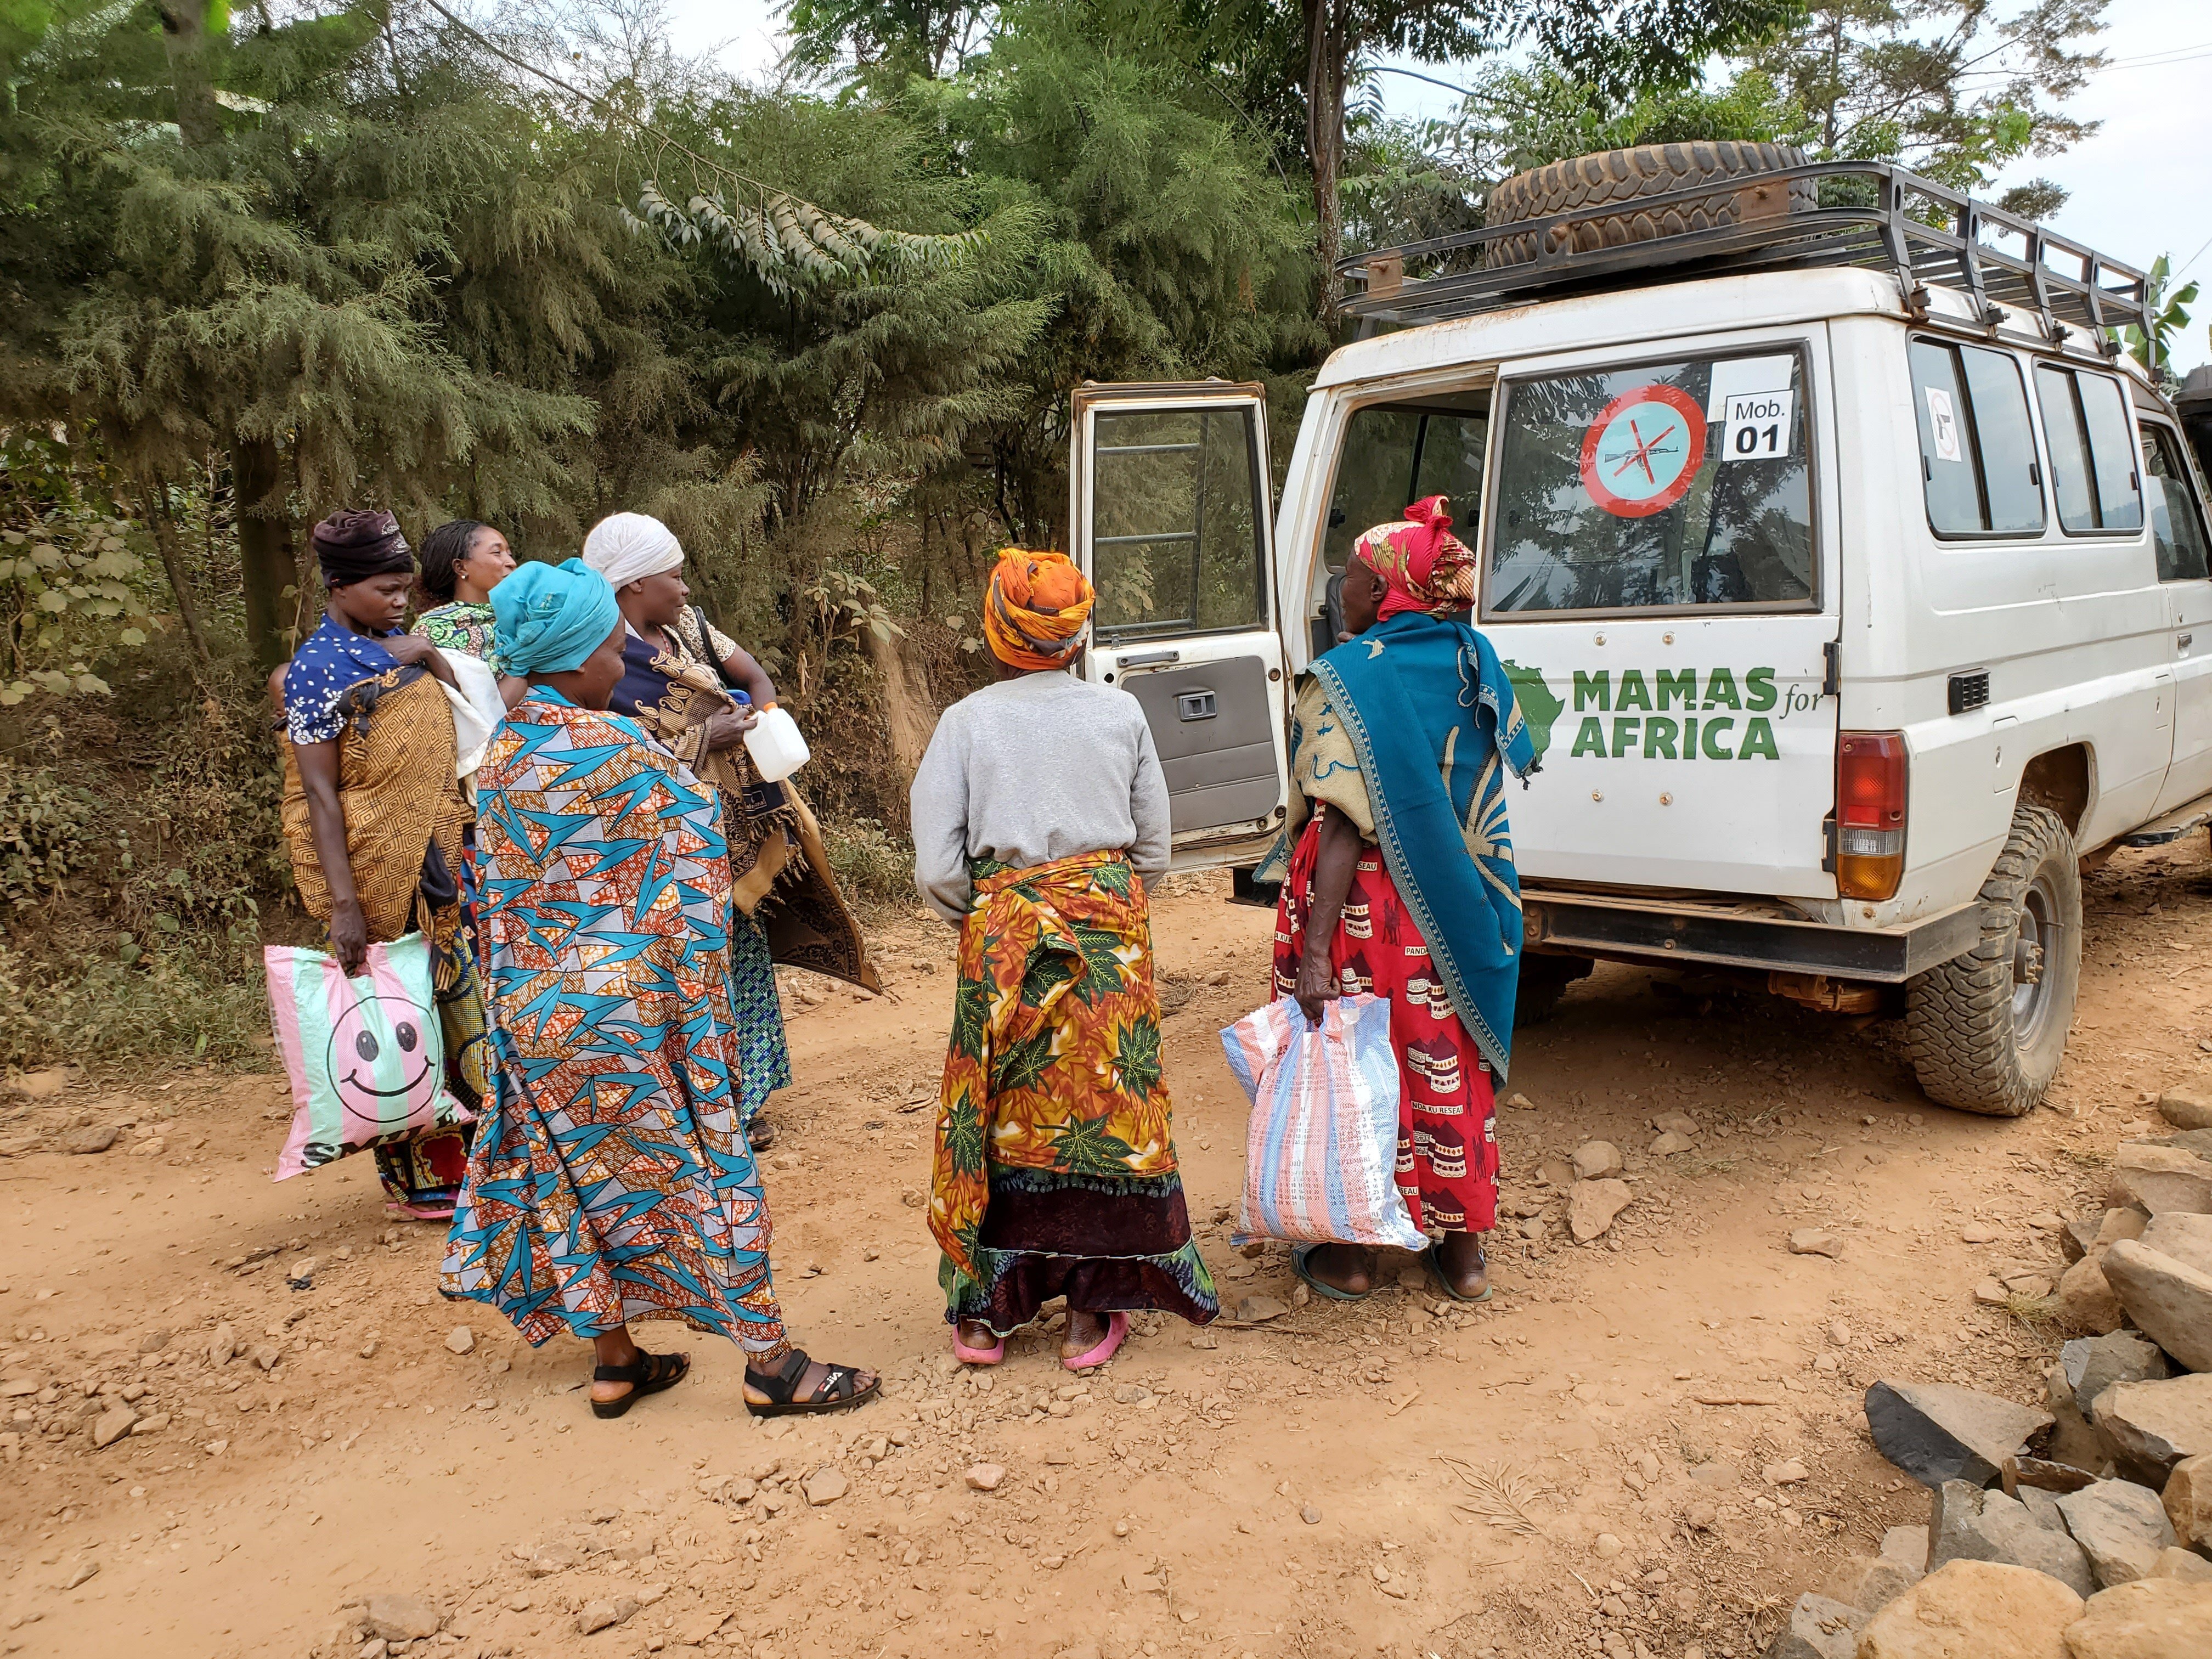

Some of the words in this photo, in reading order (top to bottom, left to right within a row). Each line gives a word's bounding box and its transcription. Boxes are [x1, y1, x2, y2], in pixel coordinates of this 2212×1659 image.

[1736, 399, 1785, 420] Mob.
[1736, 424, 1778, 454] 01
[1573, 667, 1778, 712] MAMAS
[1779, 684, 1824, 719] for
[1570, 717, 1780, 760] AFRICA
[1358, 862, 1376, 871] SEAU
[1412, 1102, 1426, 1111] NDA
[1398, 1187, 1418, 1195] SEAU
